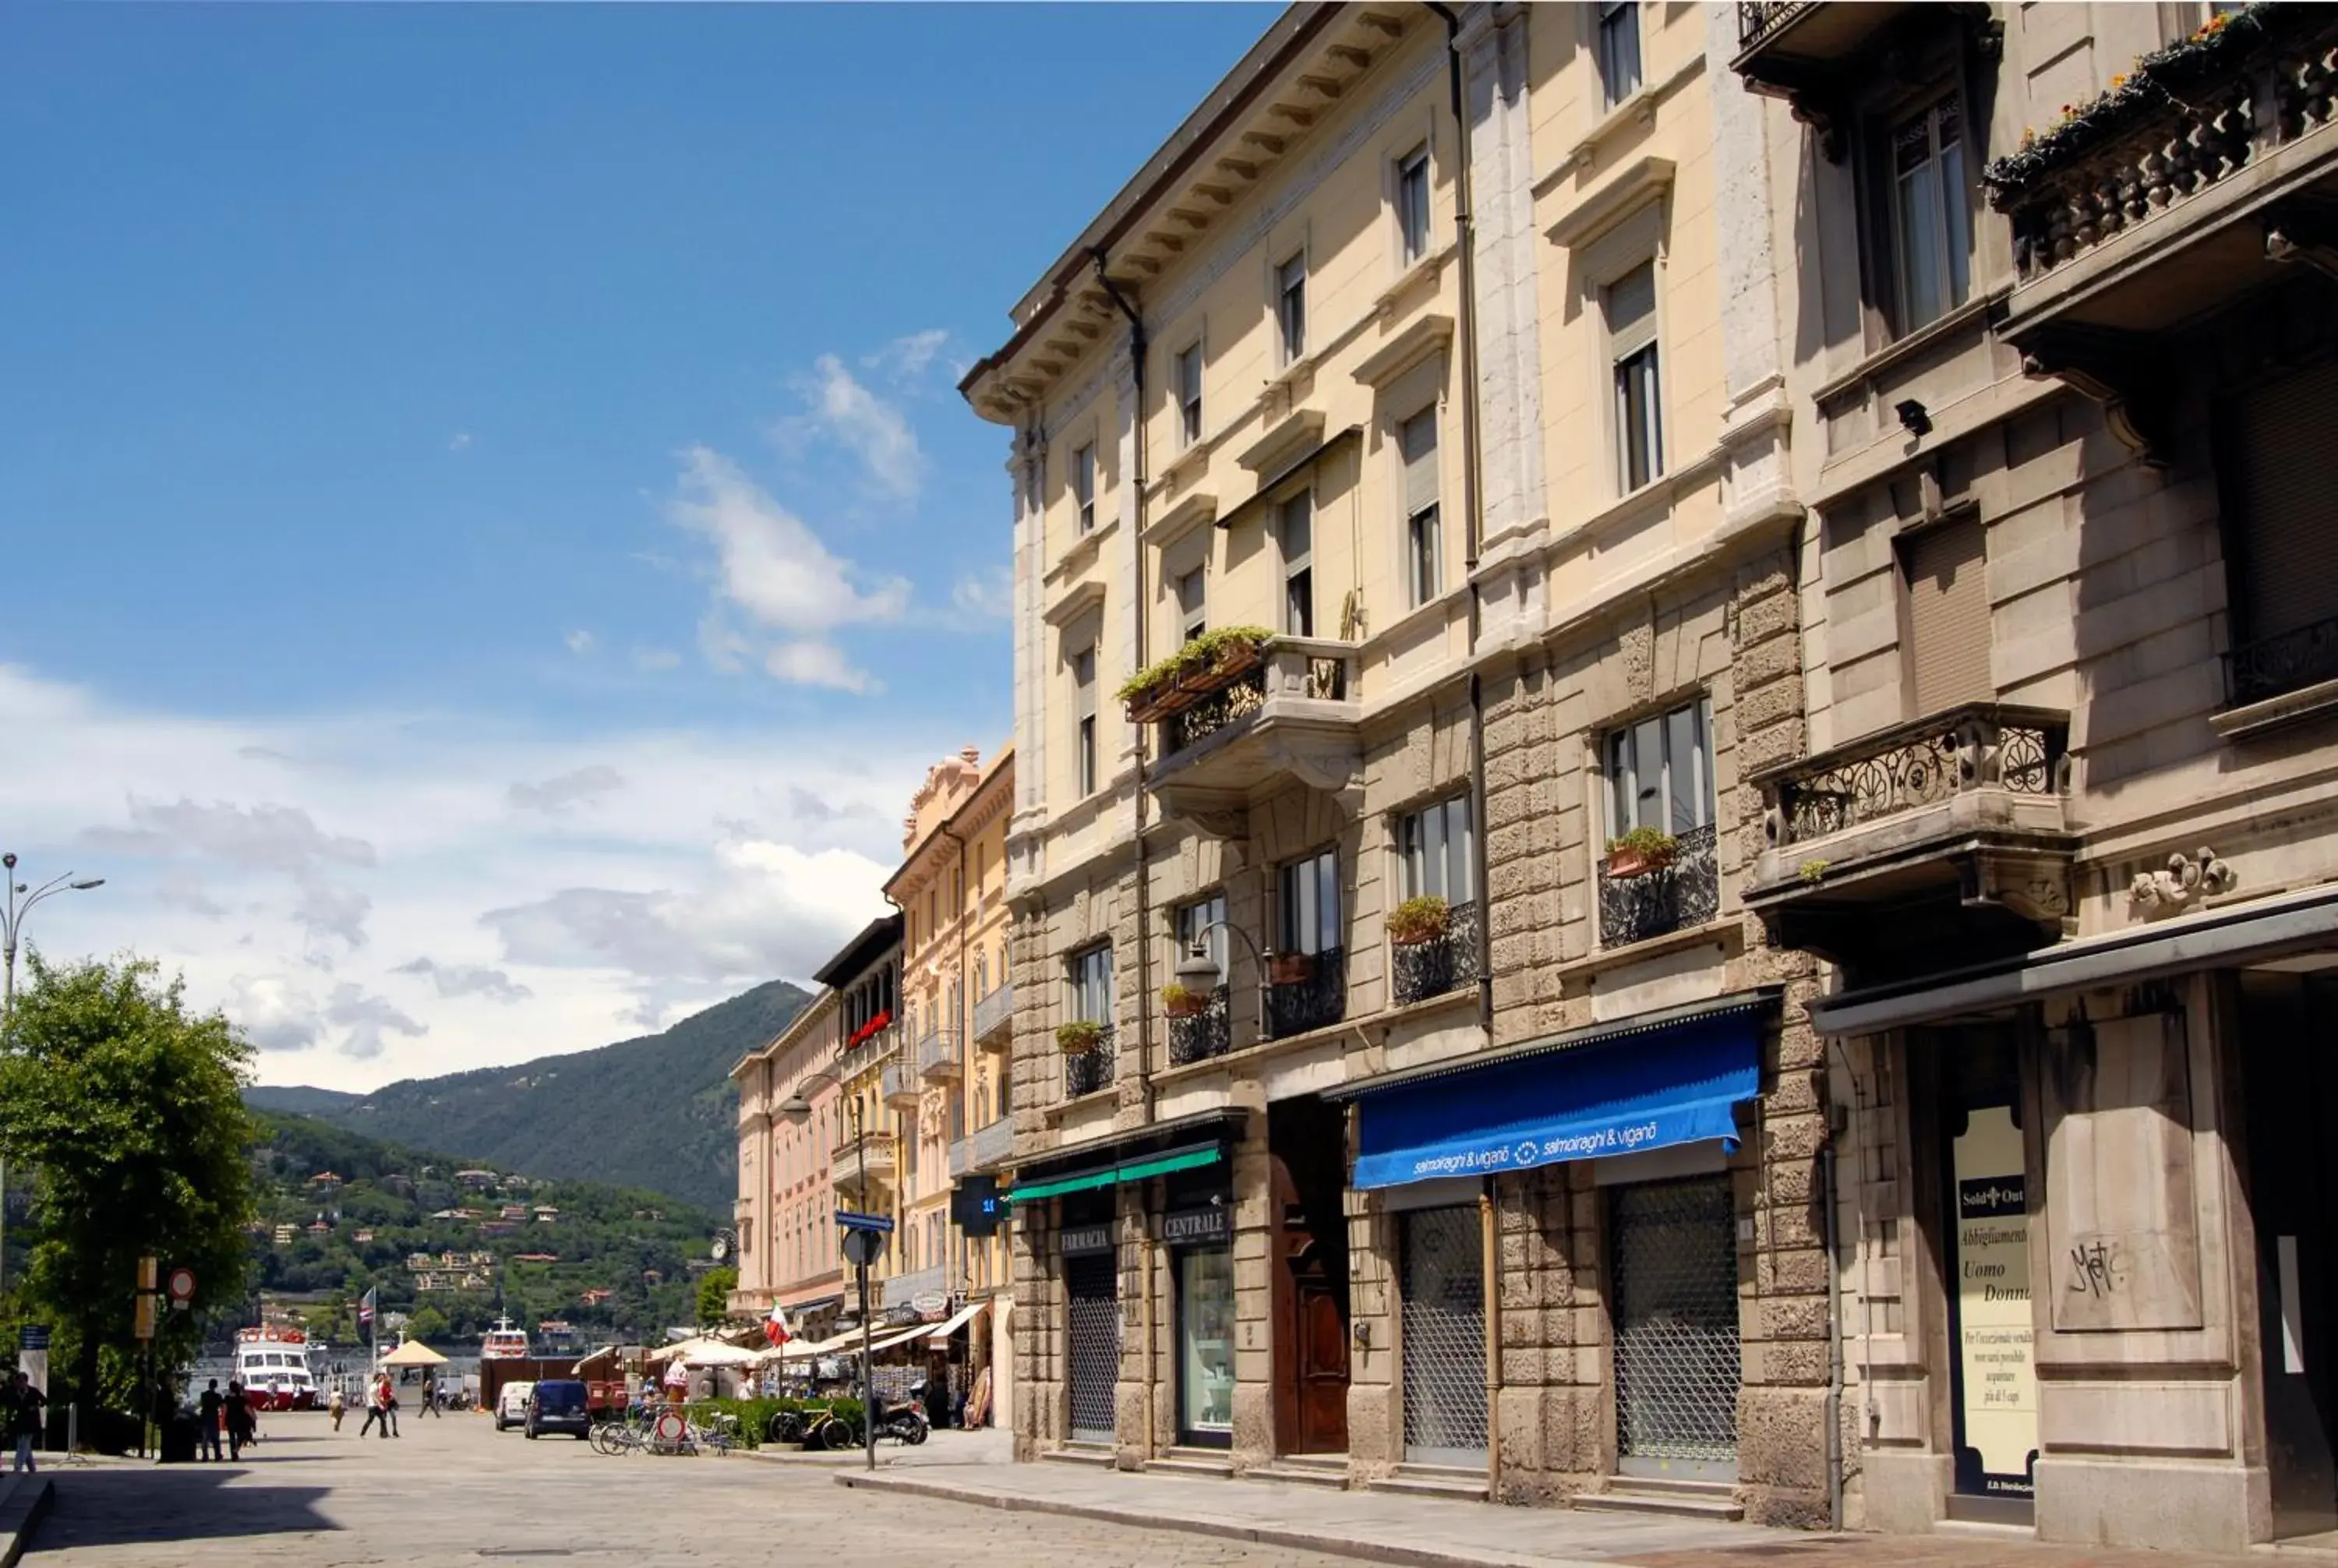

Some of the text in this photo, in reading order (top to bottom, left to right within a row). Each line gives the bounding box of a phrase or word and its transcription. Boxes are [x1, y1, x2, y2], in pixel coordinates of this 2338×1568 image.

[1606, 1128, 1616, 1146] &
[1963, 1189, 2024, 1206] Sold Out
[1165, 1213, 1223, 1238] CENTRALE
[1062, 1230, 1107, 1251] FARMACIA
[1964, 1259, 2006, 1279] Uomo
